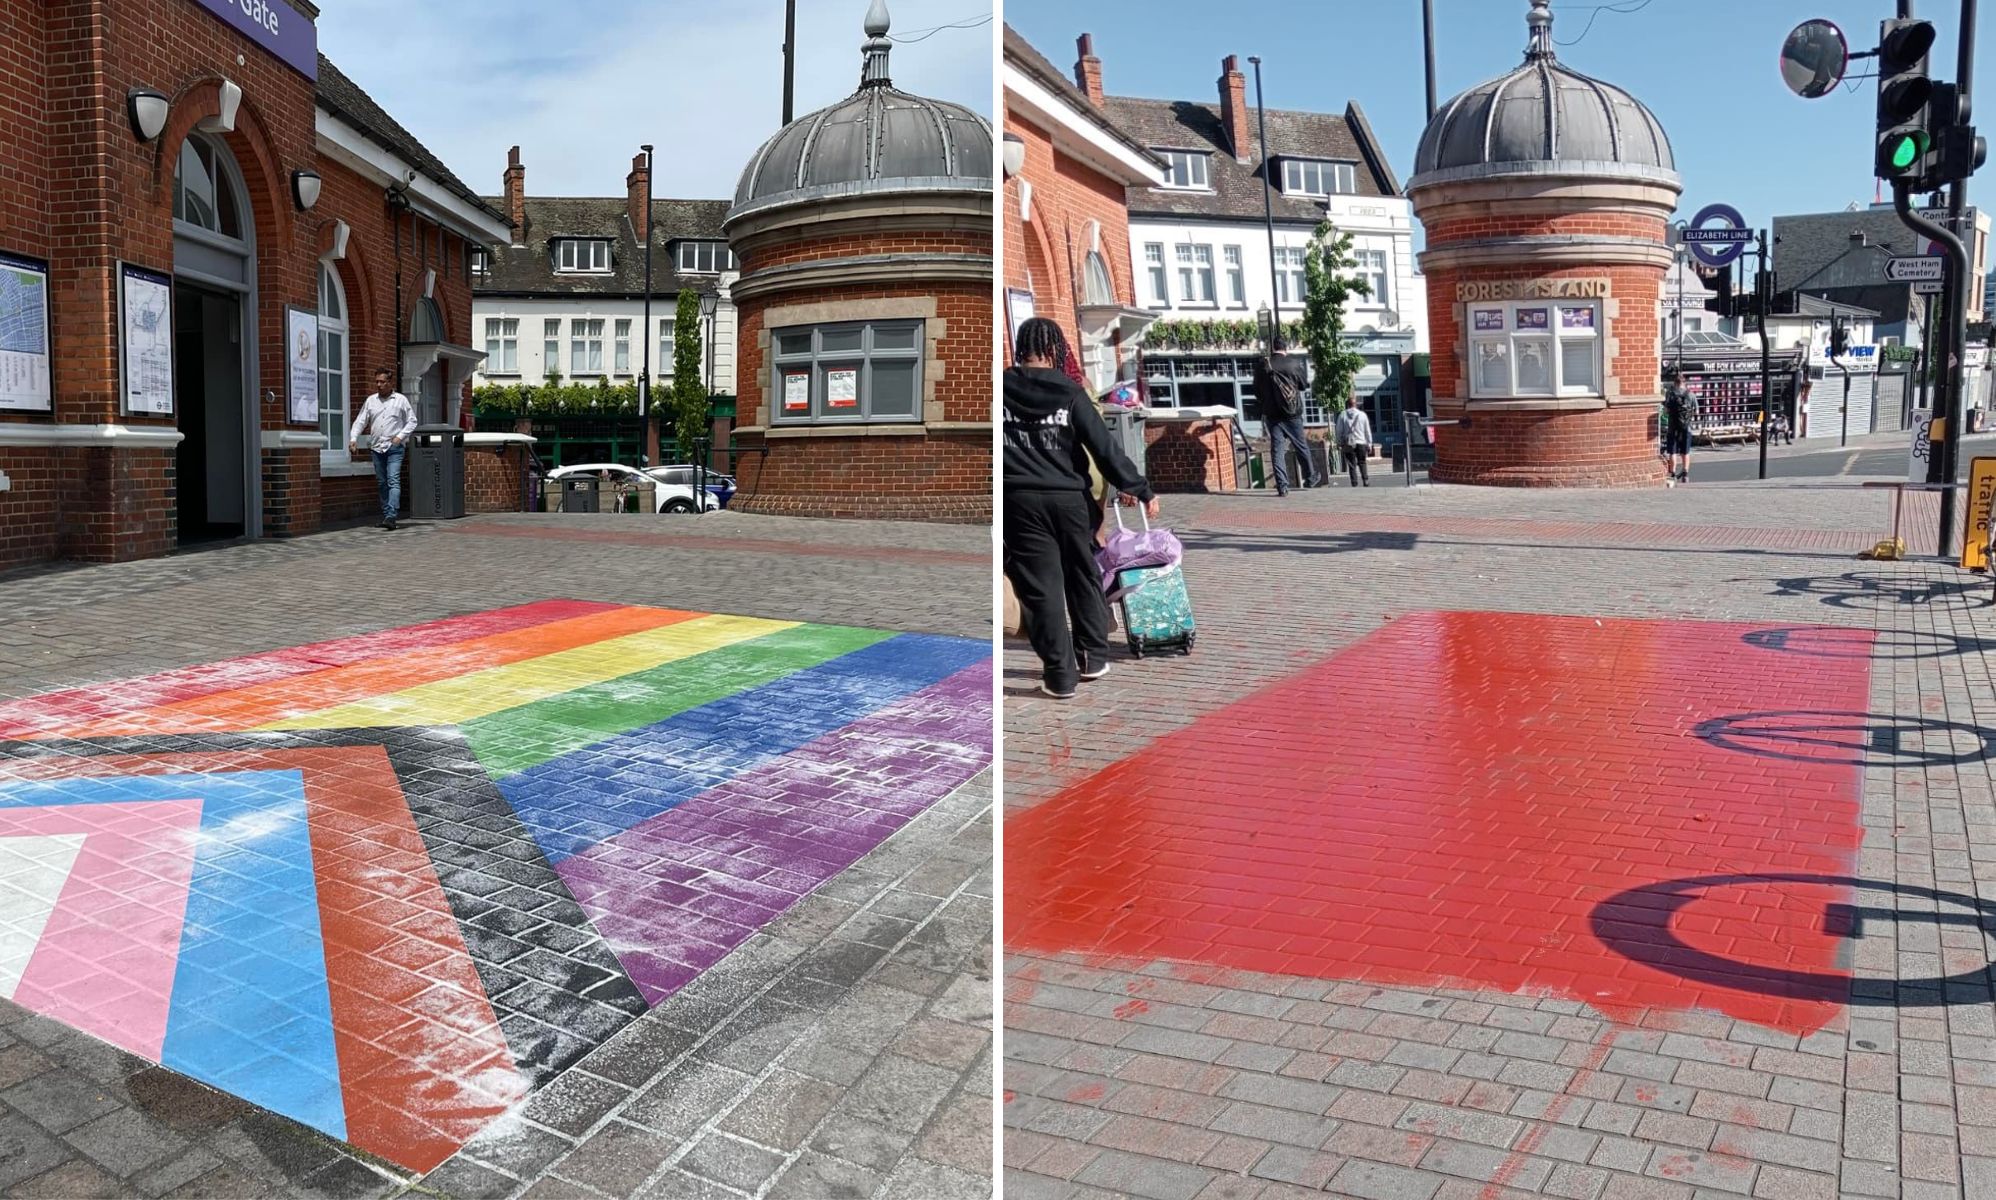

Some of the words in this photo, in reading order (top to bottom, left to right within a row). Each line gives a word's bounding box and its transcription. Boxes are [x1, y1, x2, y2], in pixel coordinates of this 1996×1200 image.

[1923, 210, 1972, 220] Contrd
[1730, 231, 1748, 239] LINE
[1921, 260, 1939, 268] Ham
[1898, 269, 1936, 277] Cemetery
[1456, 281, 1527, 301] FOREST
[1535, 279, 1607, 298] ISLAND
[1848, 346, 1876, 357] VIEW
[1703, 363, 1715, 371] THE
